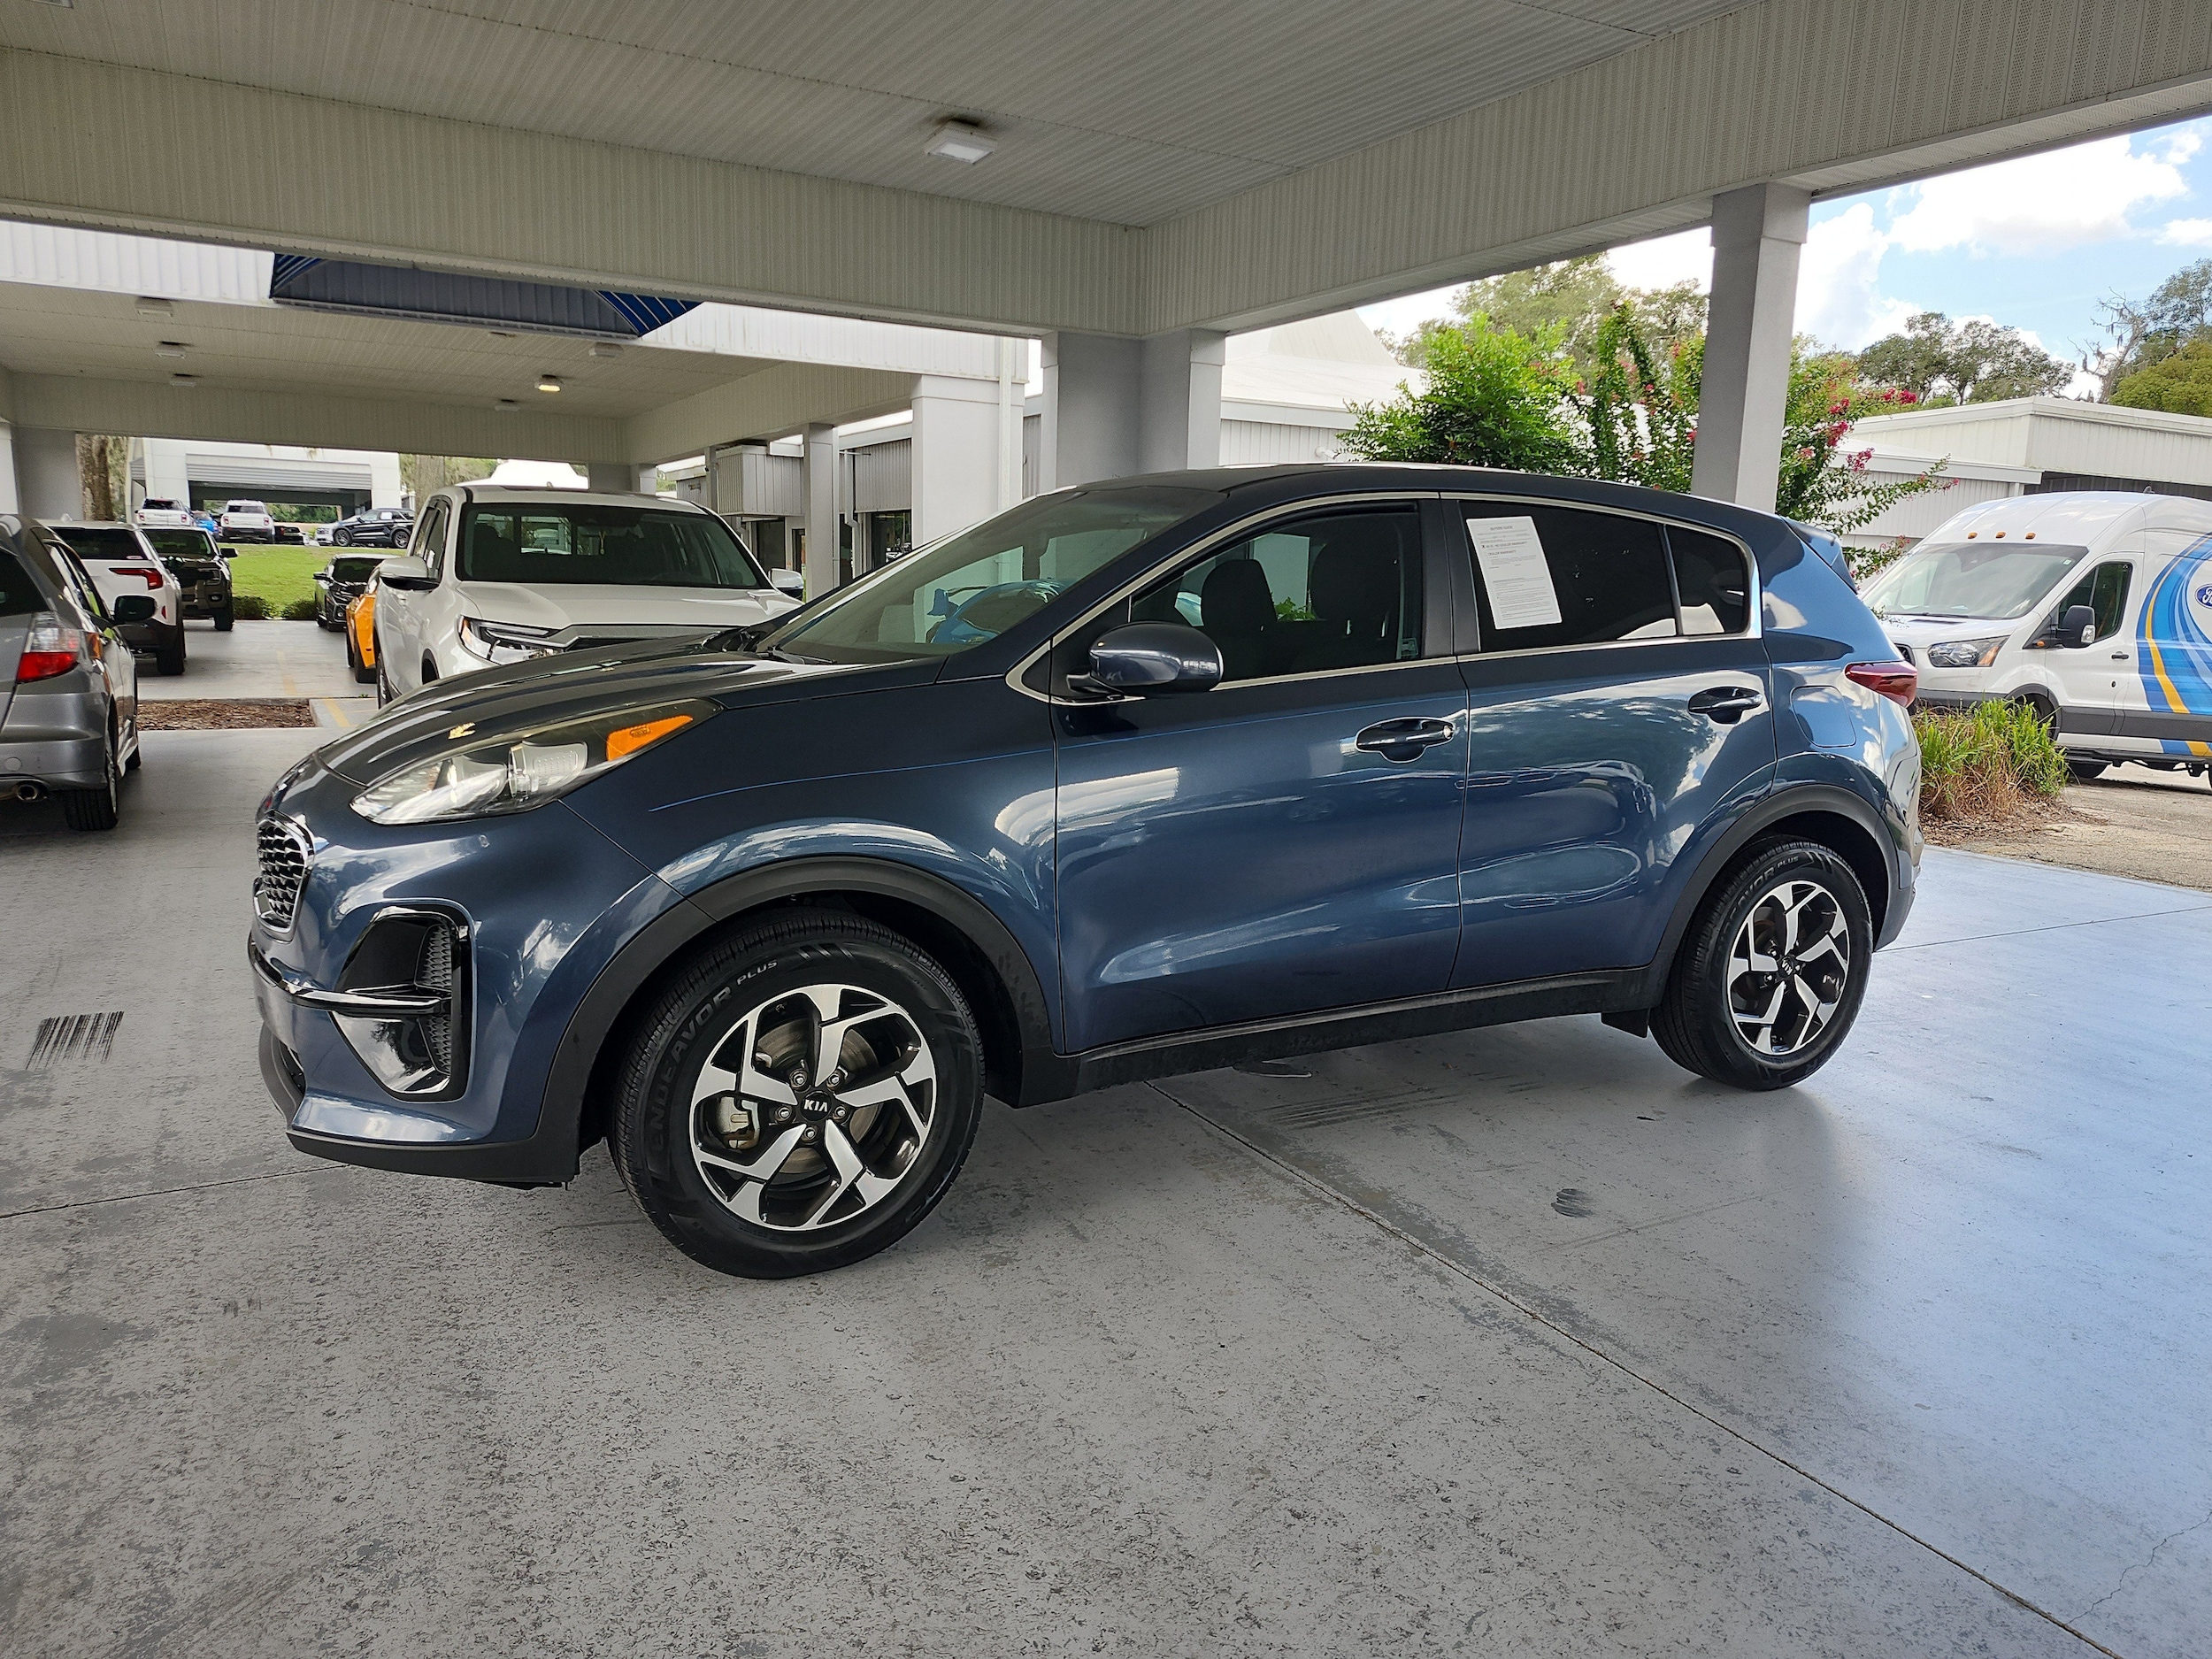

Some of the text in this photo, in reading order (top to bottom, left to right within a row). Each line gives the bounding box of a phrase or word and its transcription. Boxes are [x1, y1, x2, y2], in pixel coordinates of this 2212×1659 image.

[1777, 855, 1799, 869] PLUS
[736, 959, 779, 987] PLUS
[803, 1098, 828, 1113] KIA
